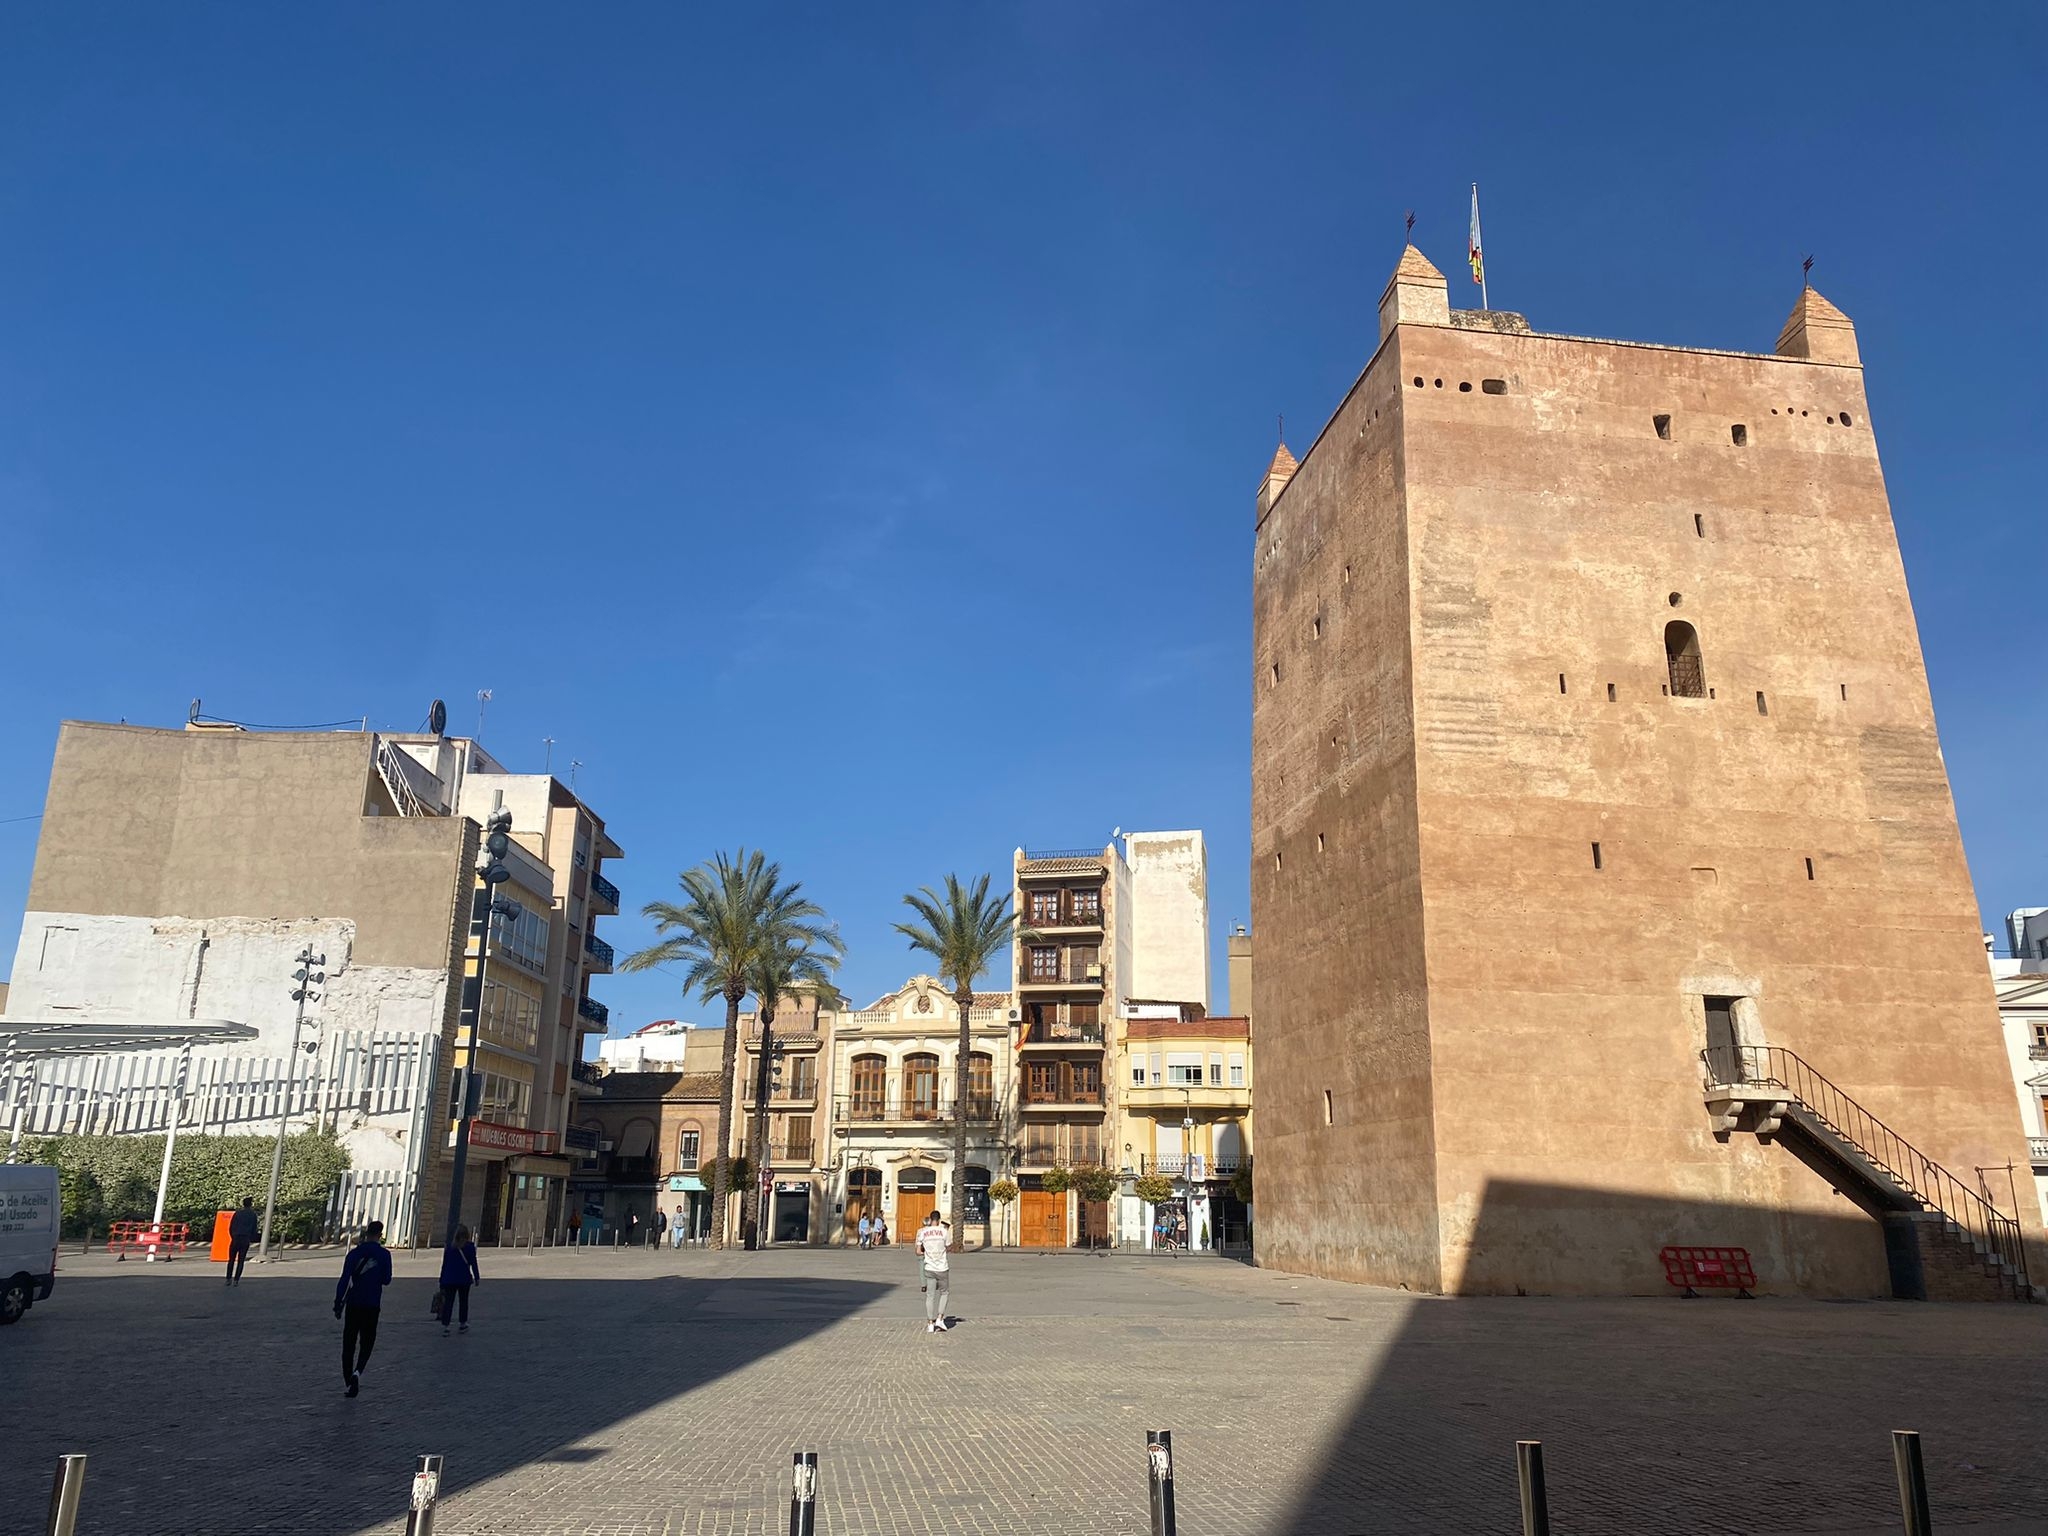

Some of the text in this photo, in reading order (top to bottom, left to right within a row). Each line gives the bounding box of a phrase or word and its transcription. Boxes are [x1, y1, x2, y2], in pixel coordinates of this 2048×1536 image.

[480, 1127, 507, 1146] MUEBLES
[7, 1195, 19, 1207] de
[21, 1194, 48, 1206] Aceite
[10, 1208, 38, 1220] Usado
